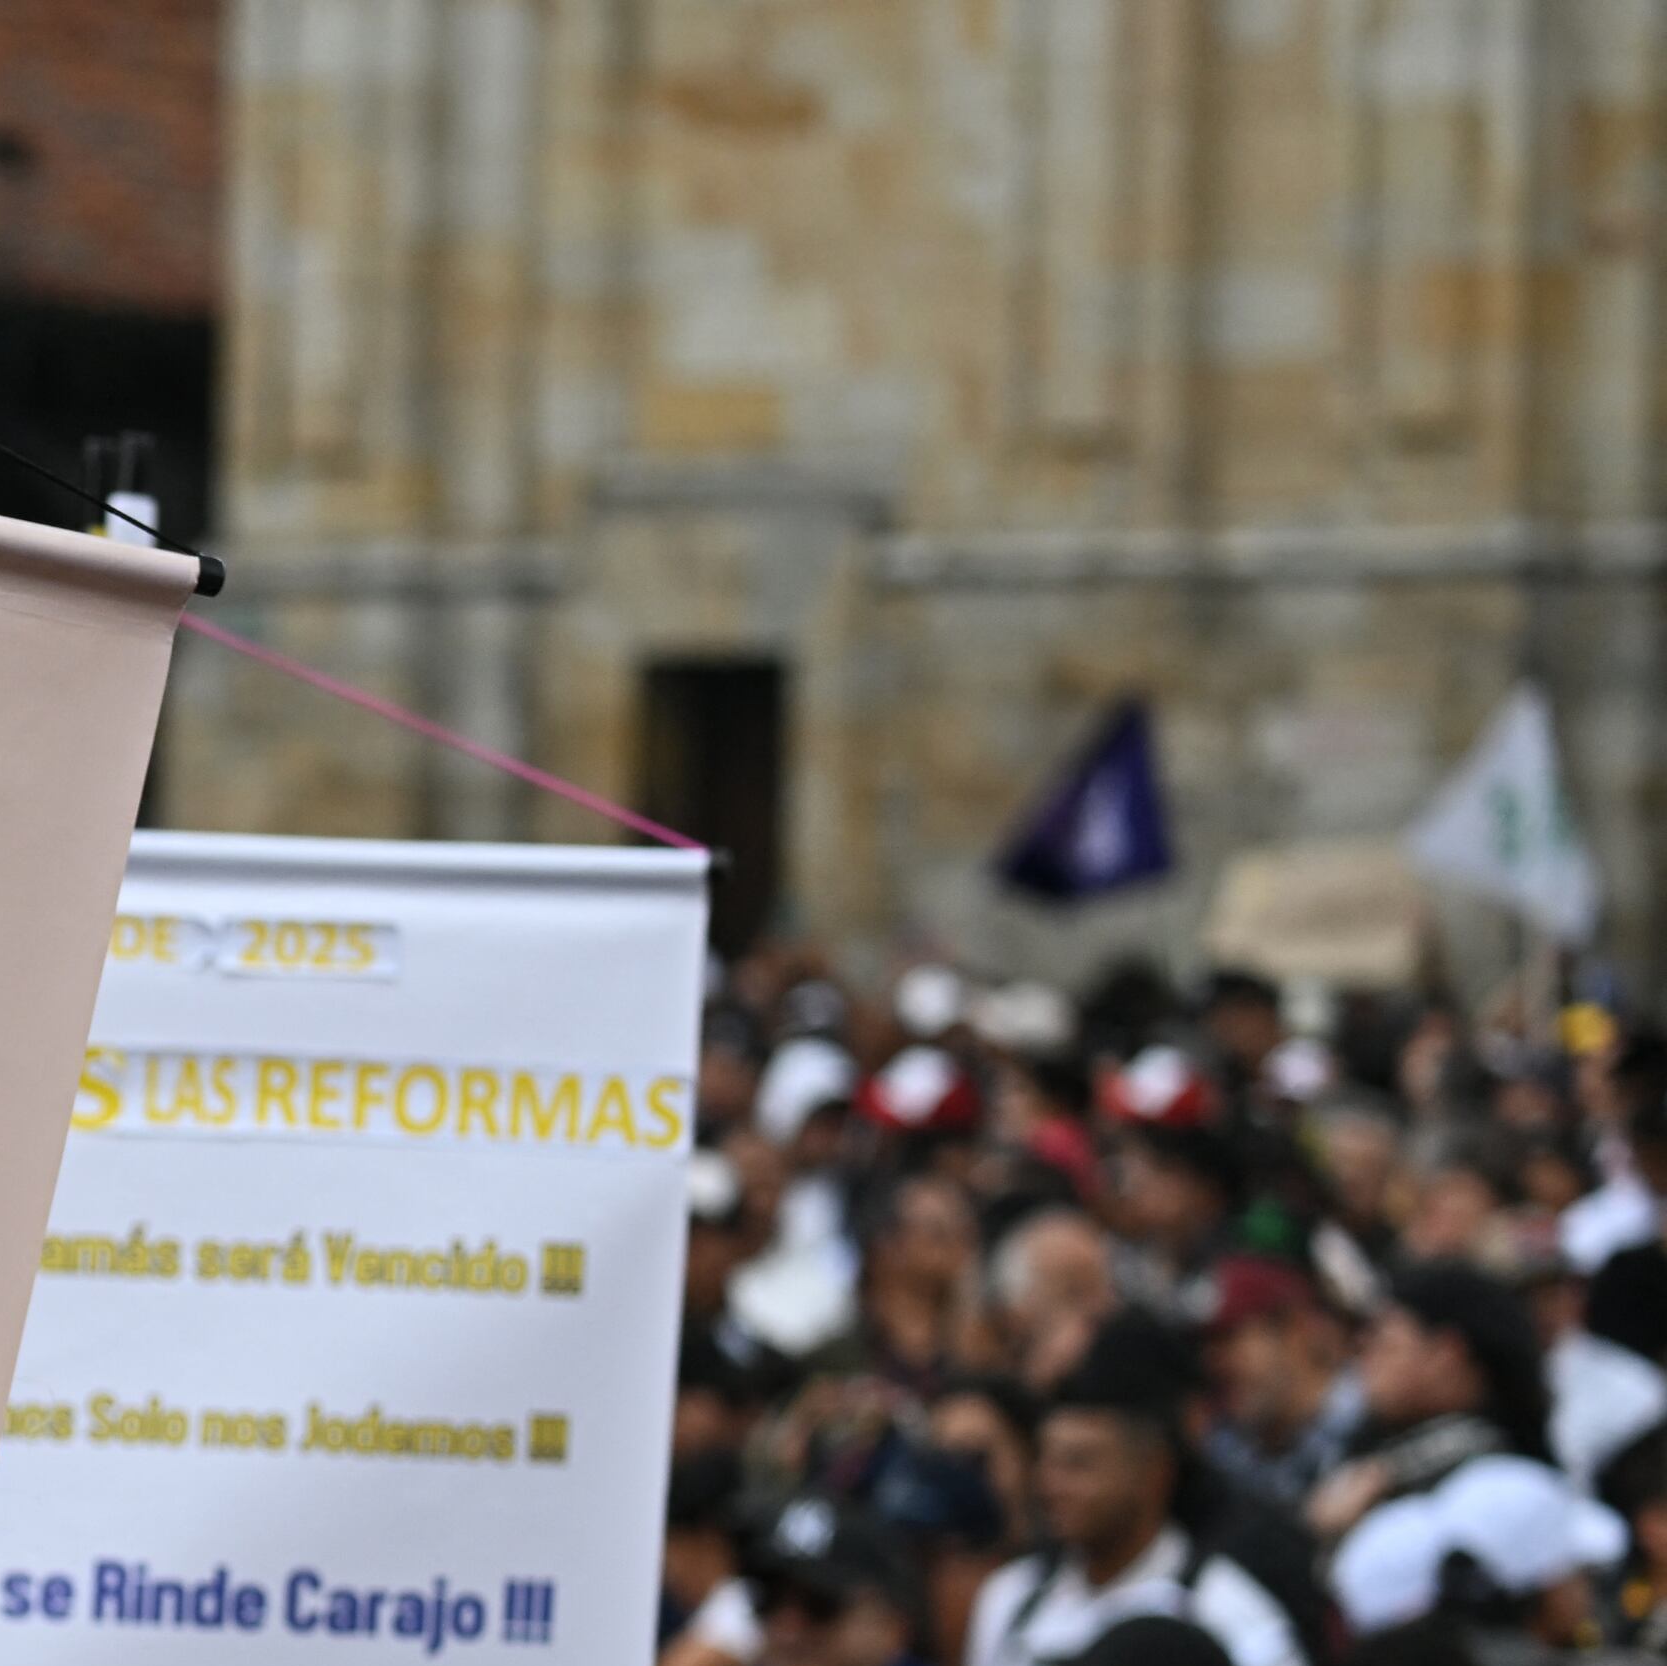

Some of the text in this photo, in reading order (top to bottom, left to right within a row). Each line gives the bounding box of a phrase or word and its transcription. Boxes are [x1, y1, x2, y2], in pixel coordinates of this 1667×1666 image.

[237, 920, 376, 969] 2025
[143, 1055, 239, 1128] LAS
[254, 1056, 684, 1150] REFORMAS
[38, 1222, 181, 1278] amás
[197, 1228, 309, 1284] será
[322, 1233, 527, 1292] Vencido
[88, 1394, 189, 1447] Solo
[200, 1405, 286, 1452] nos
[300, 1403, 515, 1461] Jodemos
[0, 1572, 74, 1620] se
[91, 1557, 266, 1630] Rinde
[281, 1568, 489, 1656] Carajo
[501, 1578, 555, 1645] !!!
